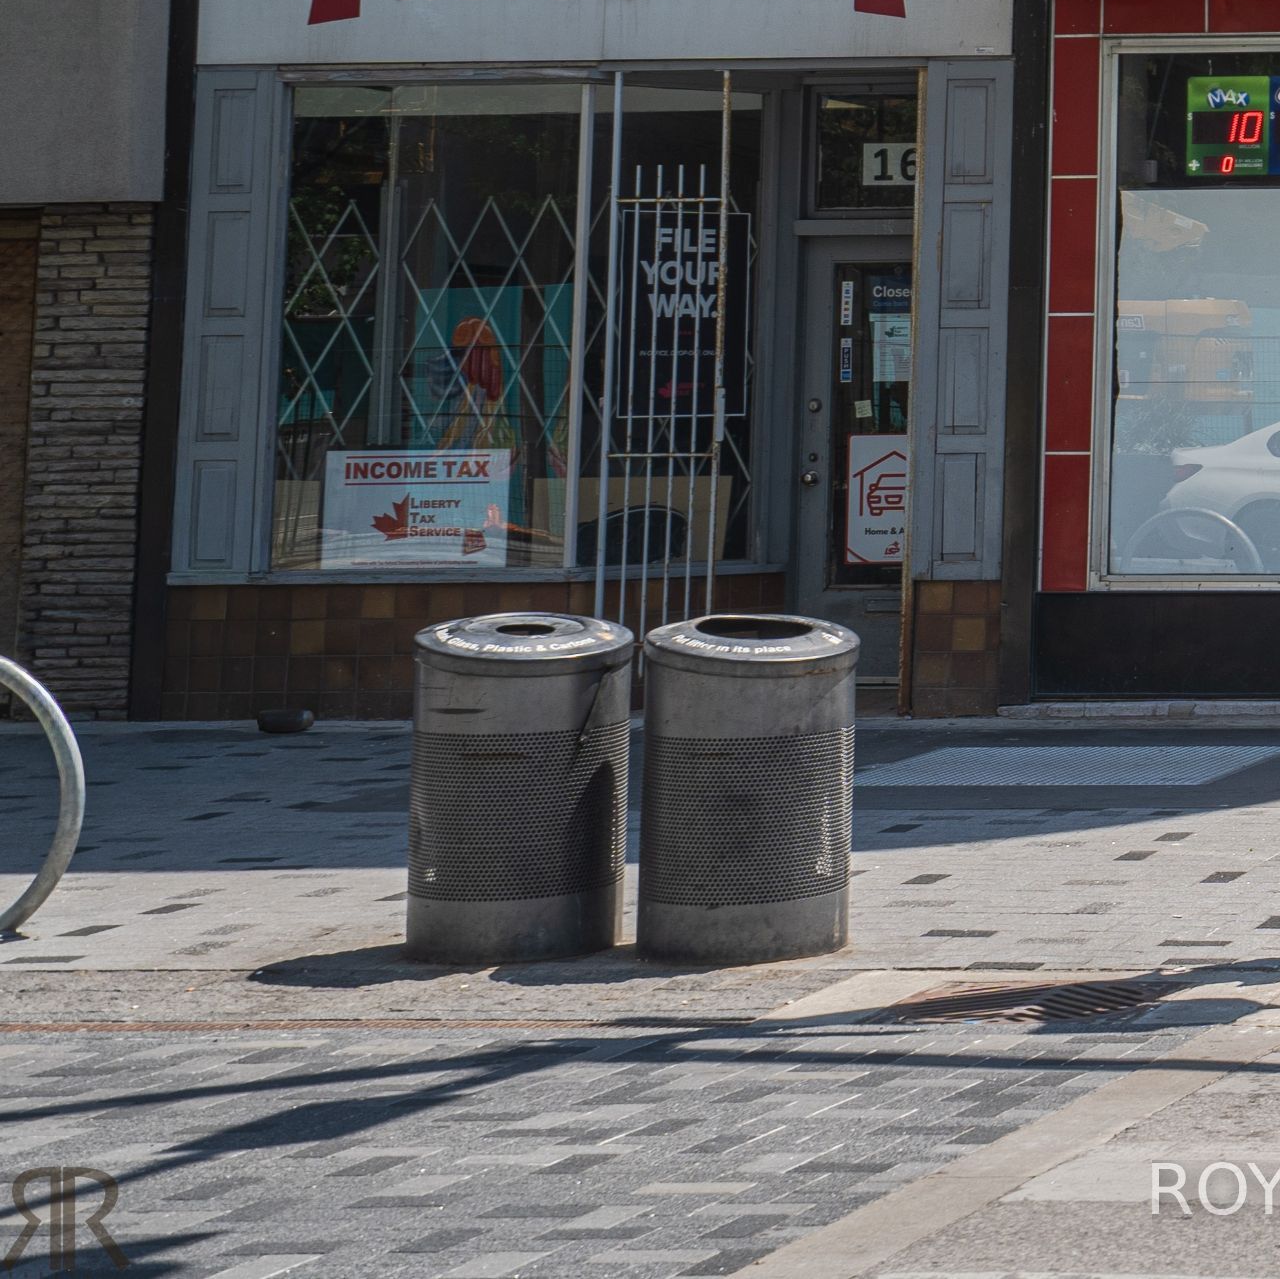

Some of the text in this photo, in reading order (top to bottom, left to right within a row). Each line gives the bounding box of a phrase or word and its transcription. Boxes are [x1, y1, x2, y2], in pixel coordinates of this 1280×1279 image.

[1207, 88, 1250, 109] MAX
[1228, 110, 1264, 143] 10
[1221, 156, 1234, 173] 0
[657, 227, 717, 253] FILE
[873, 285, 912, 298] Close
[648, 293, 720, 318] WAY.
[345, 460, 490, 480] INCOME TAX
[410, 498, 462, 509] LIBERTY
[410, 512, 436, 524] TAX
[409, 525, 461, 538] SERVICE
[865, 527, 889, 536] Home
[890, 527, 898, 535] &
[483, 643, 533, 653] Plastic
[536, 644, 547, 652] &
[549, 637, 597, 651] Cartons
[716, 644, 730, 652] in
[732, 645, 750, 653] its
[754, 645, 791, 654] place
